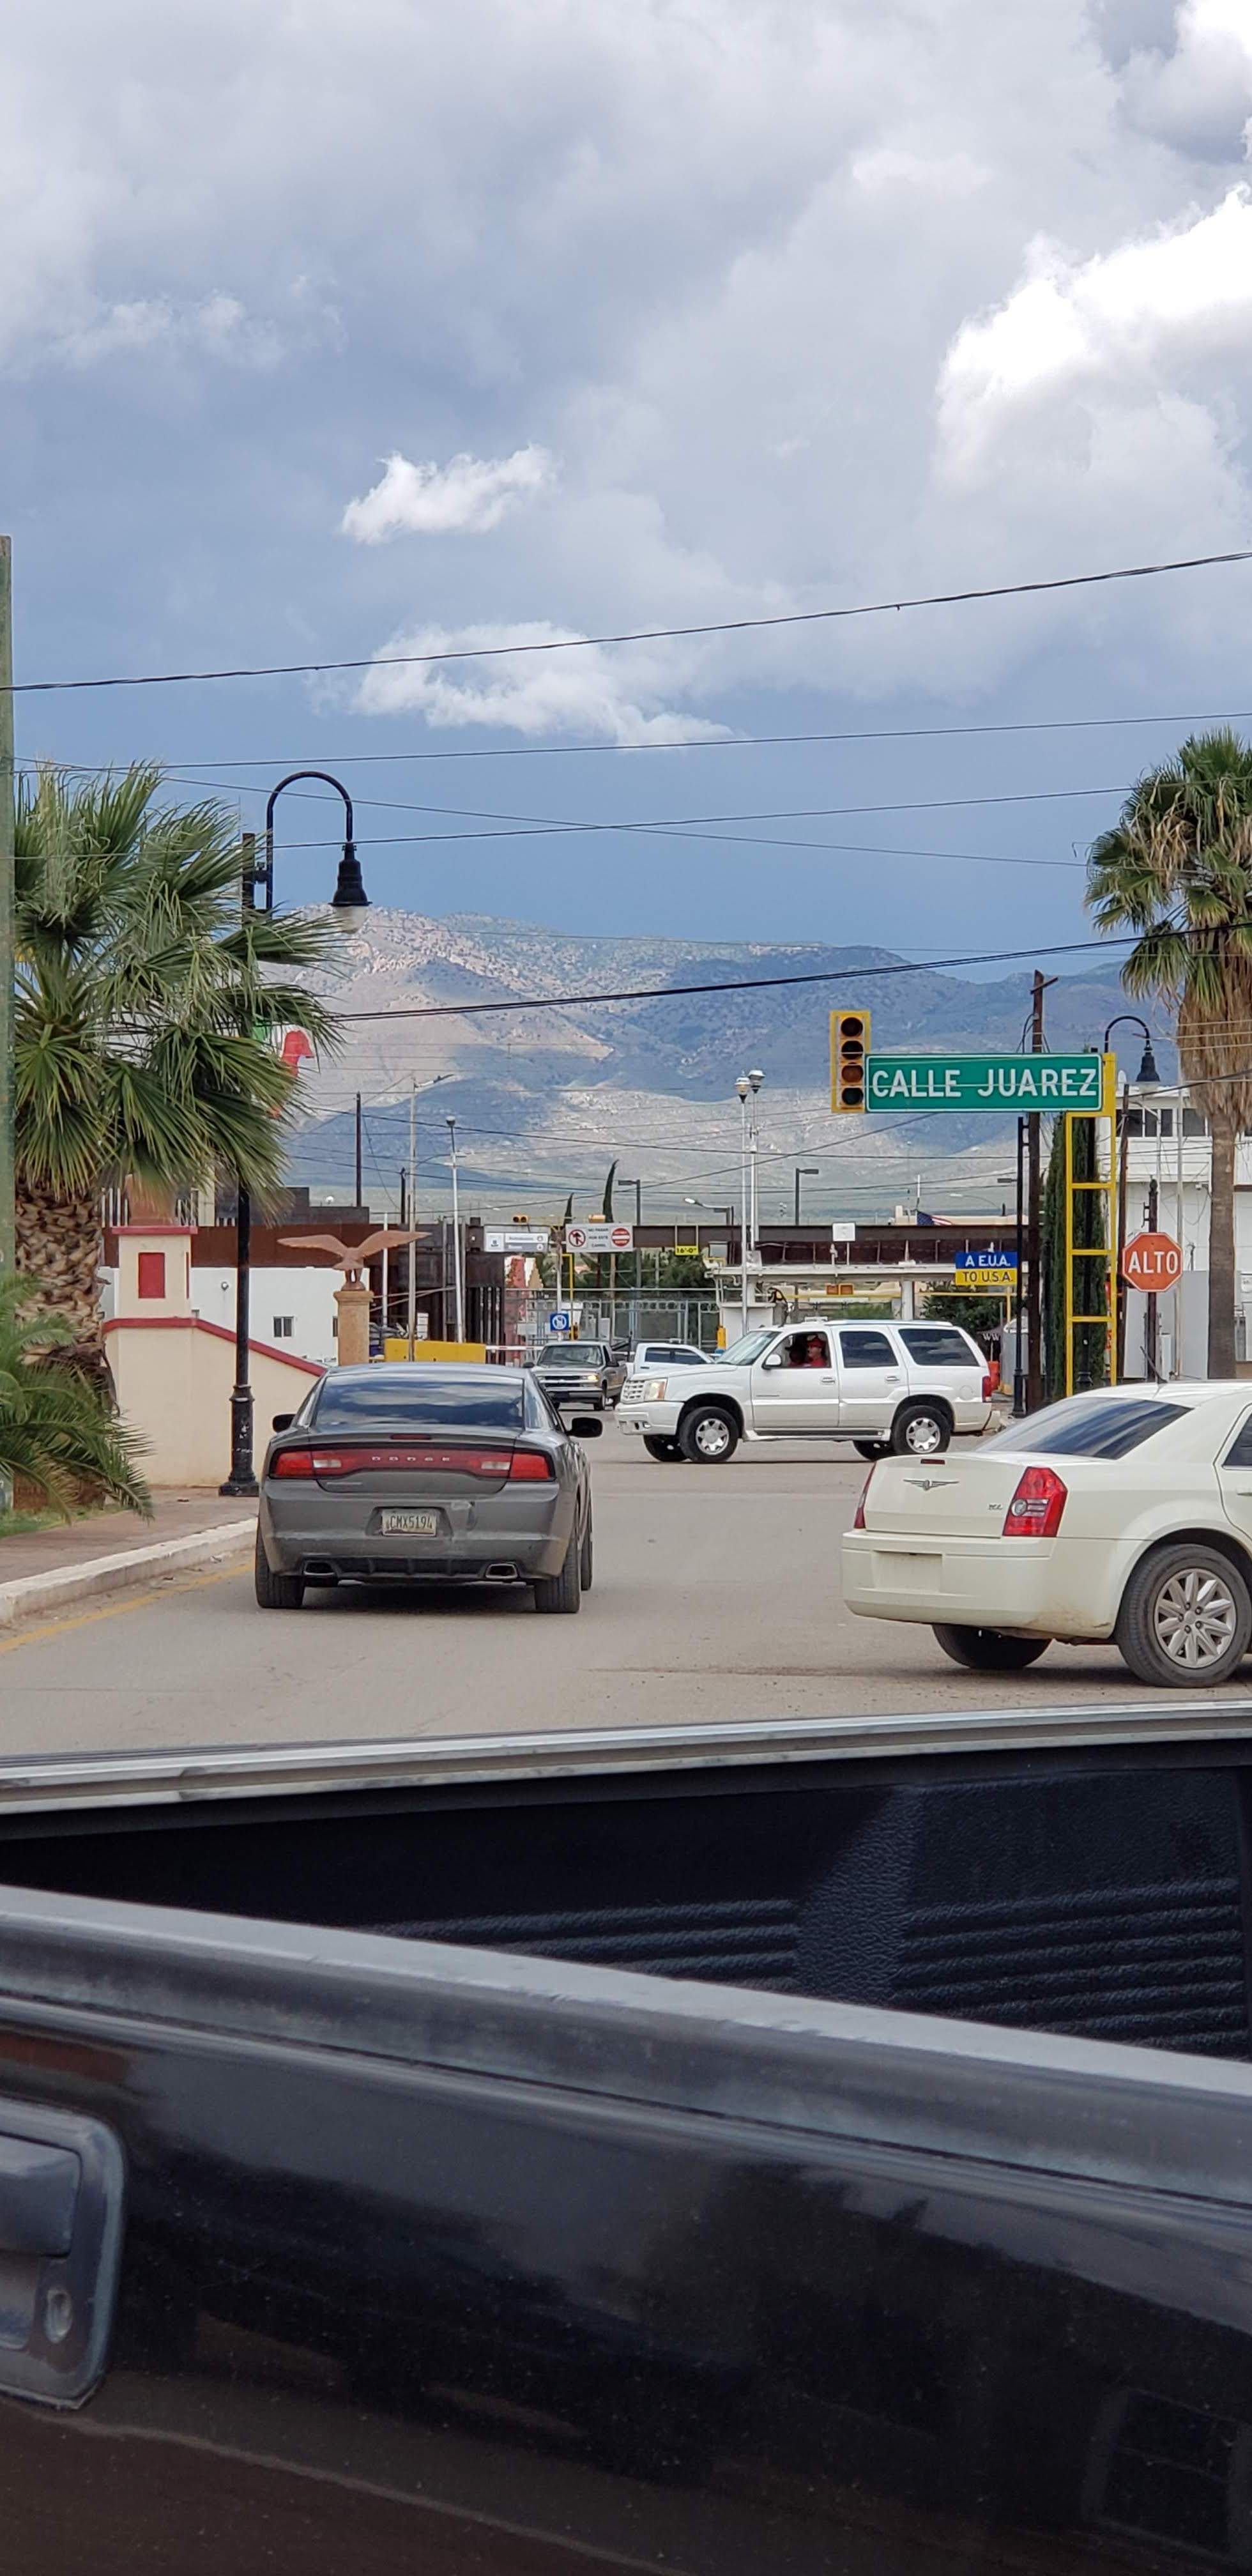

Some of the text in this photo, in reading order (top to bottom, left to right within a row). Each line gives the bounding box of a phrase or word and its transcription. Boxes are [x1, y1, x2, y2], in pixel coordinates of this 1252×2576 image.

[872, 1068, 1097, 1097] CALLE JUAREZ
[965, 1255, 1011, 1267] A E.U.A.
[1128, 1250, 1179, 1275] ALTO
[963, 1271, 978, 1282] TO
[390, 1515, 432, 1529] CMX5194
